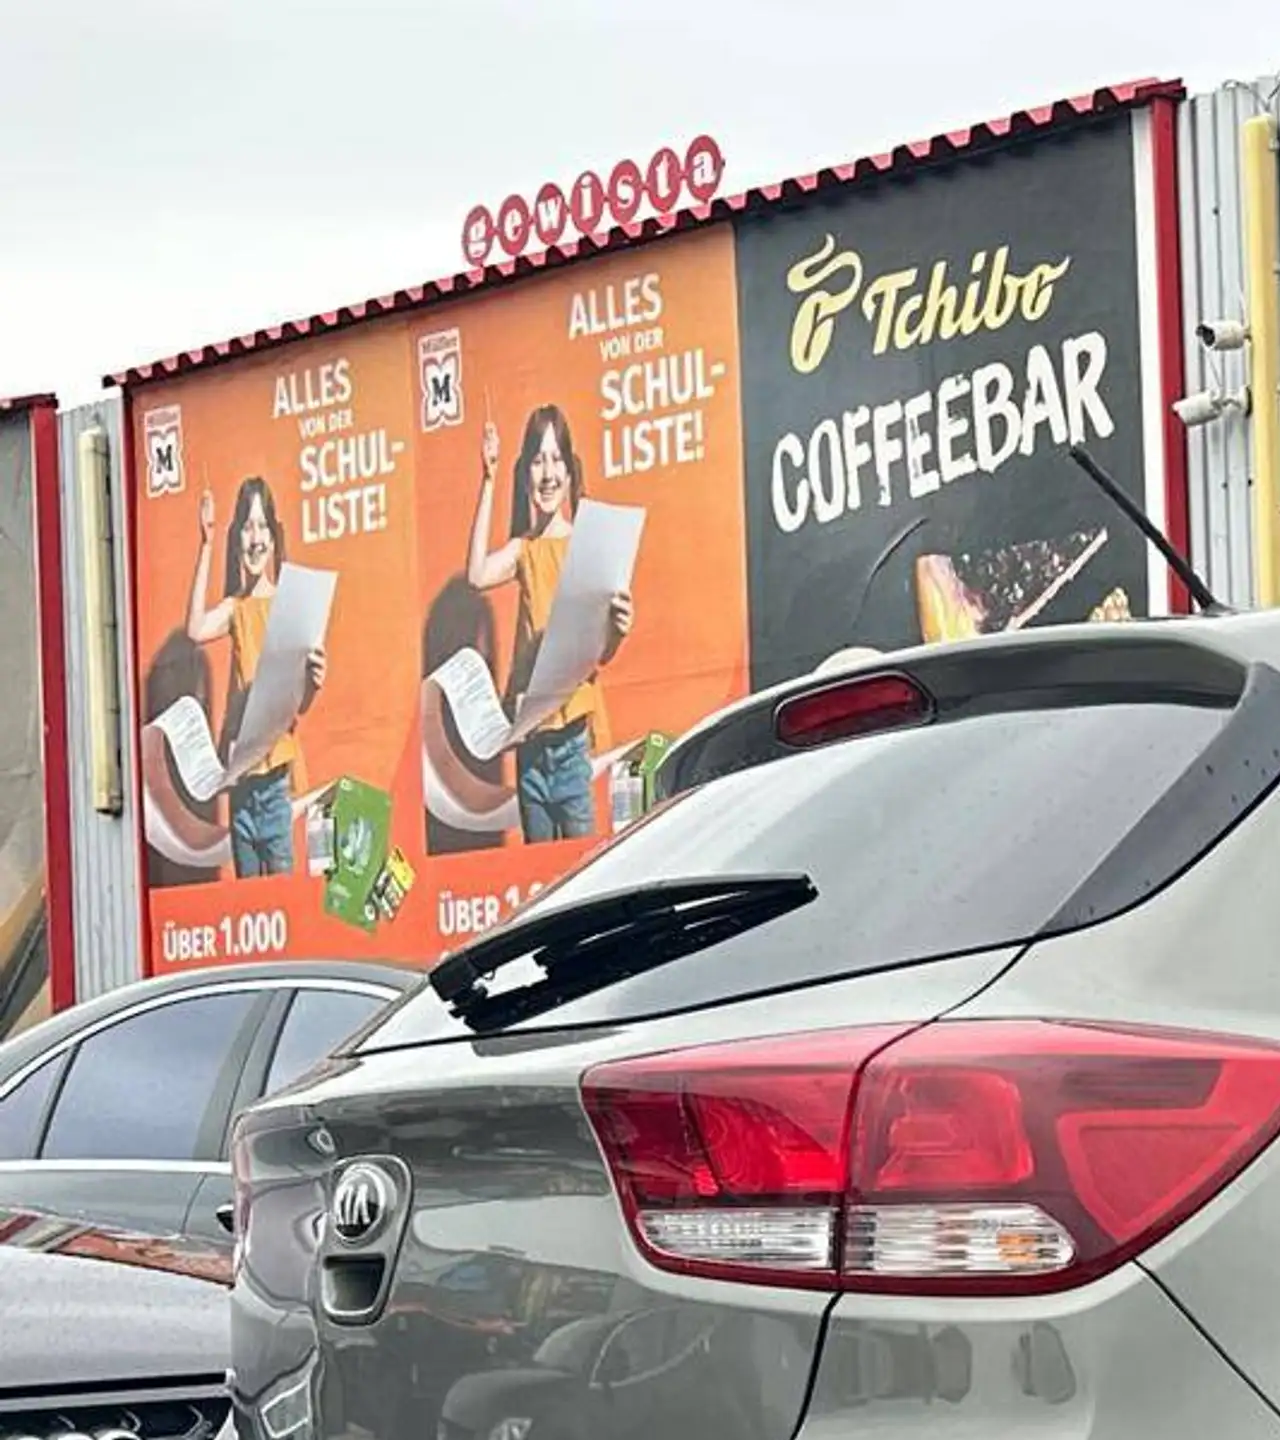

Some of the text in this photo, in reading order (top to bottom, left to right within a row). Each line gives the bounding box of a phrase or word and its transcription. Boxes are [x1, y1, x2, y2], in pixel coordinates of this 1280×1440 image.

[463, 146, 718, 260] gewista
[569, 273, 662, 340] ALLES
[862, 246, 1072, 356] Tchibo
[600, 327, 664, 362] VON DER
[272, 358, 352, 419] ALLES
[599, 348, 726, 423] SCHUL-
[300, 409, 354, 440] VON DER
[602, 410, 705, 479] LISTE!
[772, 331, 1115, 534] COFFEEBAR
[299, 430, 405, 492] SCHUL-
[302, 484, 387, 544] LISTE!
[162, 909, 287, 962] ÜBER 1.000
[439, 889, 501, 936] ÜBER
